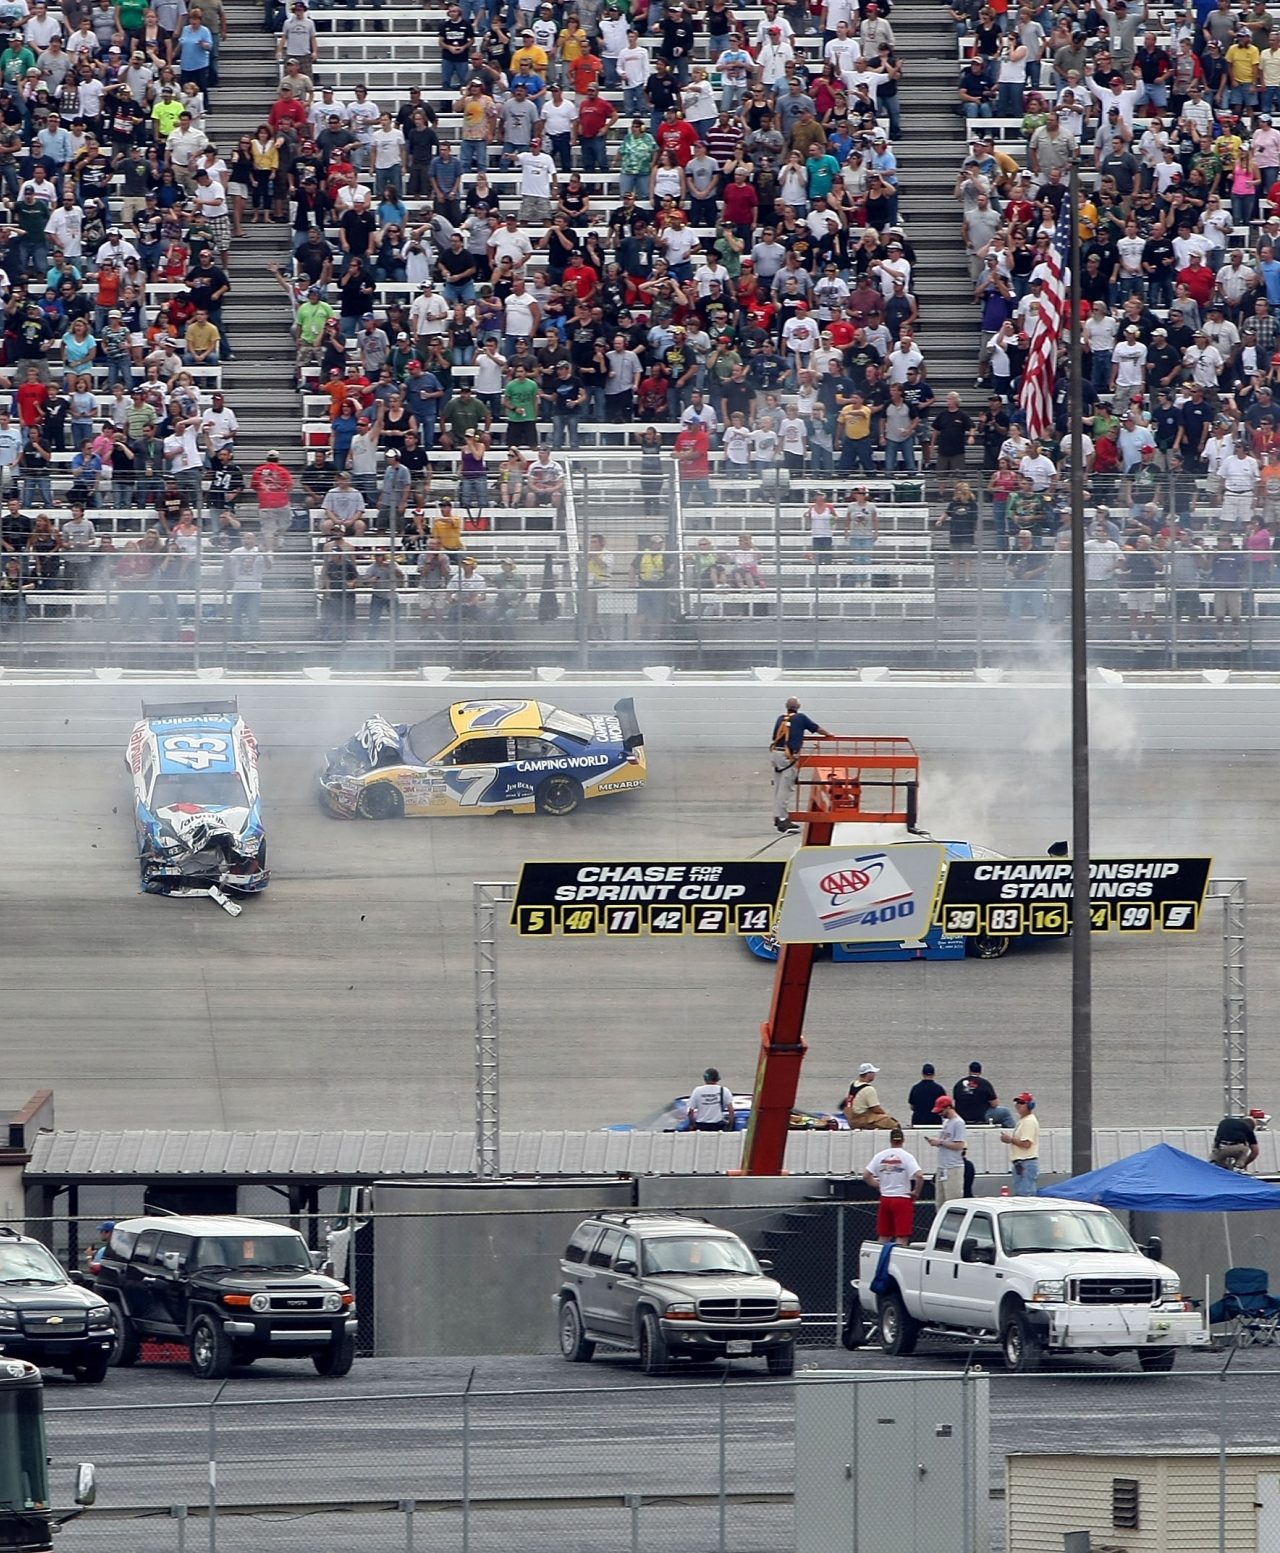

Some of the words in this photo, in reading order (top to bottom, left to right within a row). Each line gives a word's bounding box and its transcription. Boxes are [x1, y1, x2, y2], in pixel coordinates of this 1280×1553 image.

[463, 701, 527, 728] 7
[163, 736, 228, 770] 43
[516, 758, 568, 772] CAMPING
[567, 755, 609, 768] WORLD
[457, 767, 498, 806] 7
[576, 866, 686, 882] CHASE
[691, 866, 723, 874] FOR
[689, 874, 720, 882] THE
[825, 870, 869, 894] AAA
[974, 863, 1179, 881] CHAMPNSHIP
[554, 885, 678, 901] SPRINT
[678, 885, 746, 901] CUP
[1000, 882, 1153, 899] STANINGS
[528, 912, 544, 931] 5
[565, 911, 592, 930] 48
[610, 911, 636, 930] 11
[652, 911, 680, 930] 42
[697, 910, 723, 930] 2
[740, 910, 768, 930] 14
[860, 901, 915, 926] 400
[947, 910, 975, 930] 39
[991, 909, 1018, 930] 83
[1034, 909, 1061, 928] 16
[1121, 907, 1150, 927] 99
